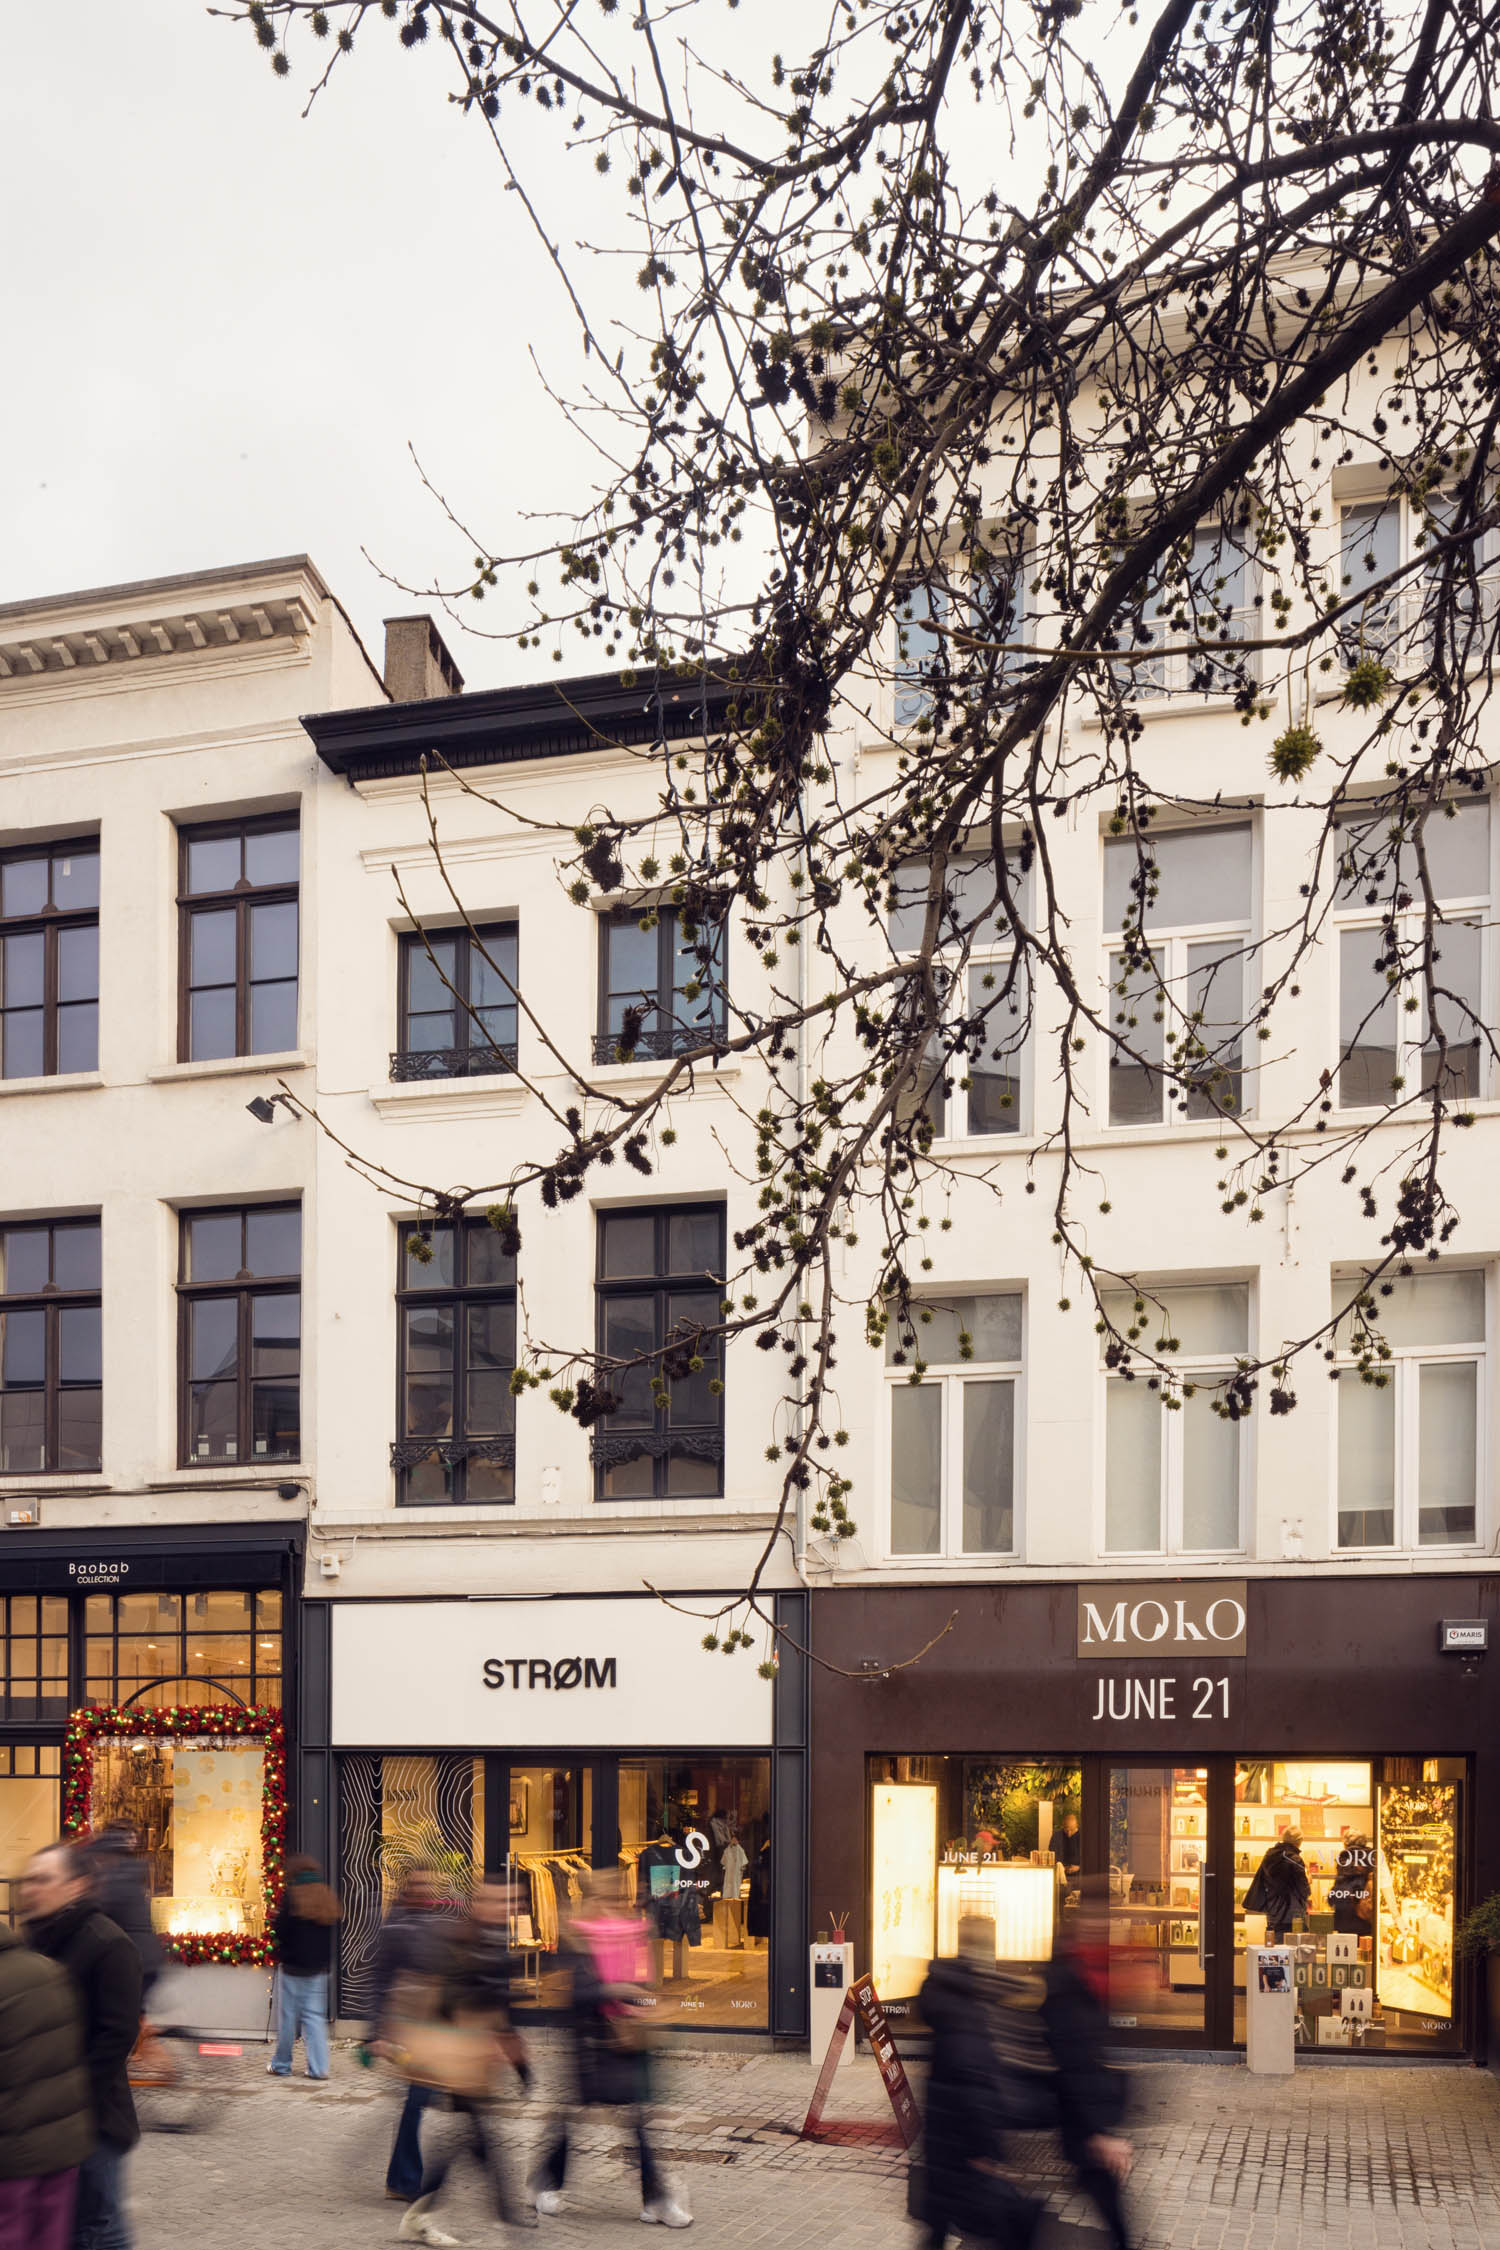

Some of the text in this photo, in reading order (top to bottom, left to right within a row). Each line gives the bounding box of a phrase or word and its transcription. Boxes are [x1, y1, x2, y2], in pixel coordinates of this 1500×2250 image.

[69, 1562, 129, 1574] Baobab
[77, 1576, 120, 1584] COLLECTION
[482, 1655, 618, 1691] STRØM
[1092, 1677, 1230, 1720] JUNE 21
[674, 1831, 710, 1869] S
[943, 1852, 997, 1864] JUNE 21
[674, 1880, 710, 1888] POP-UP
[1329, 1890, 1370, 1899] POP-UP
[729, 2000, 757, 2009] MORO
[1421, 2021, 1452, 2031] MORO
